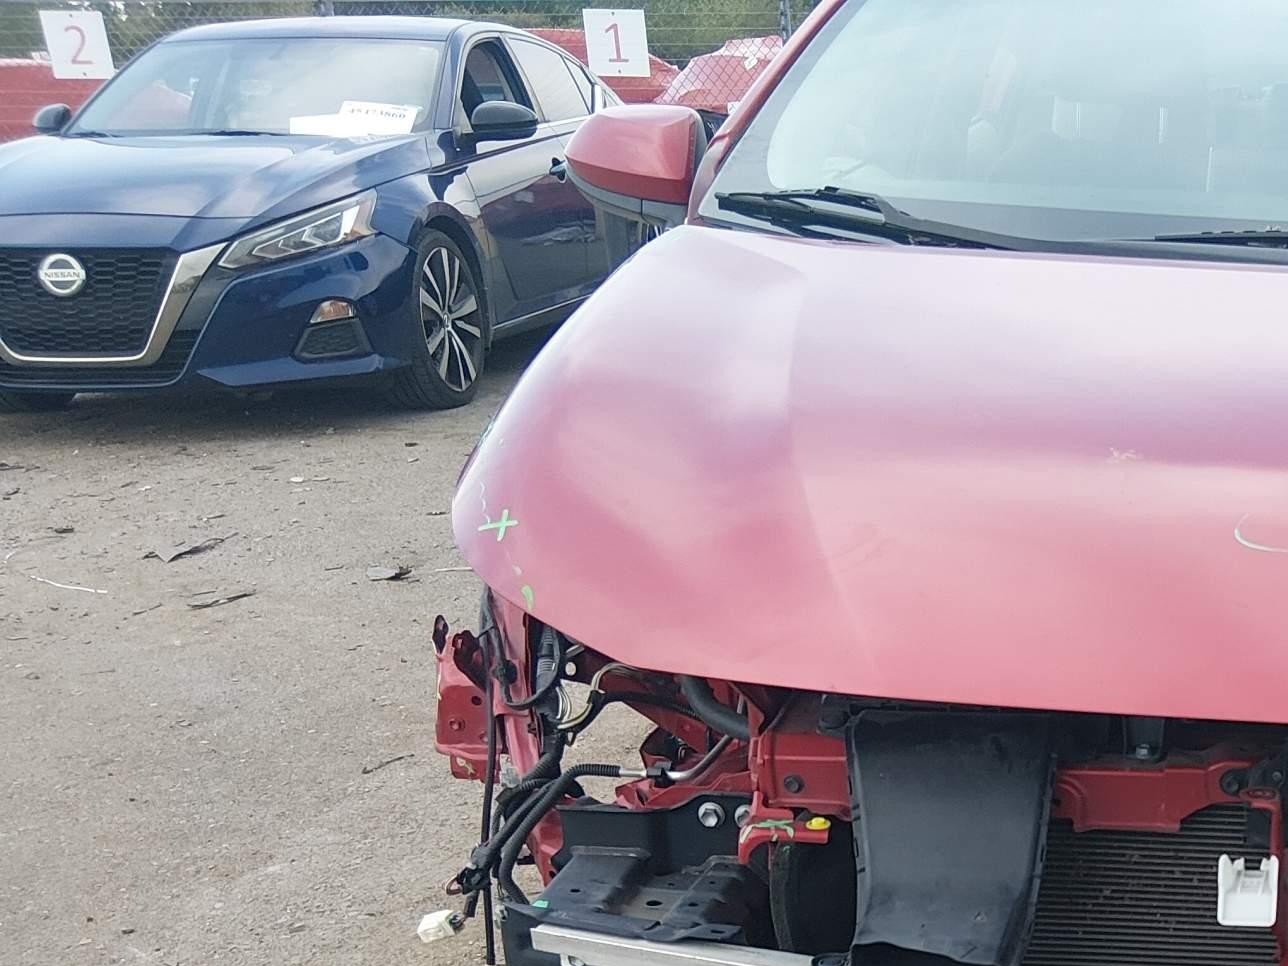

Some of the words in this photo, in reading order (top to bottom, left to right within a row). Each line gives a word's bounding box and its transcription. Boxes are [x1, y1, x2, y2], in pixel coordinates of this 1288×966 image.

[64, 25, 94, 65] 2
[604, 23, 629, 63] 1
[43, 271, 80, 279] NISSAN
